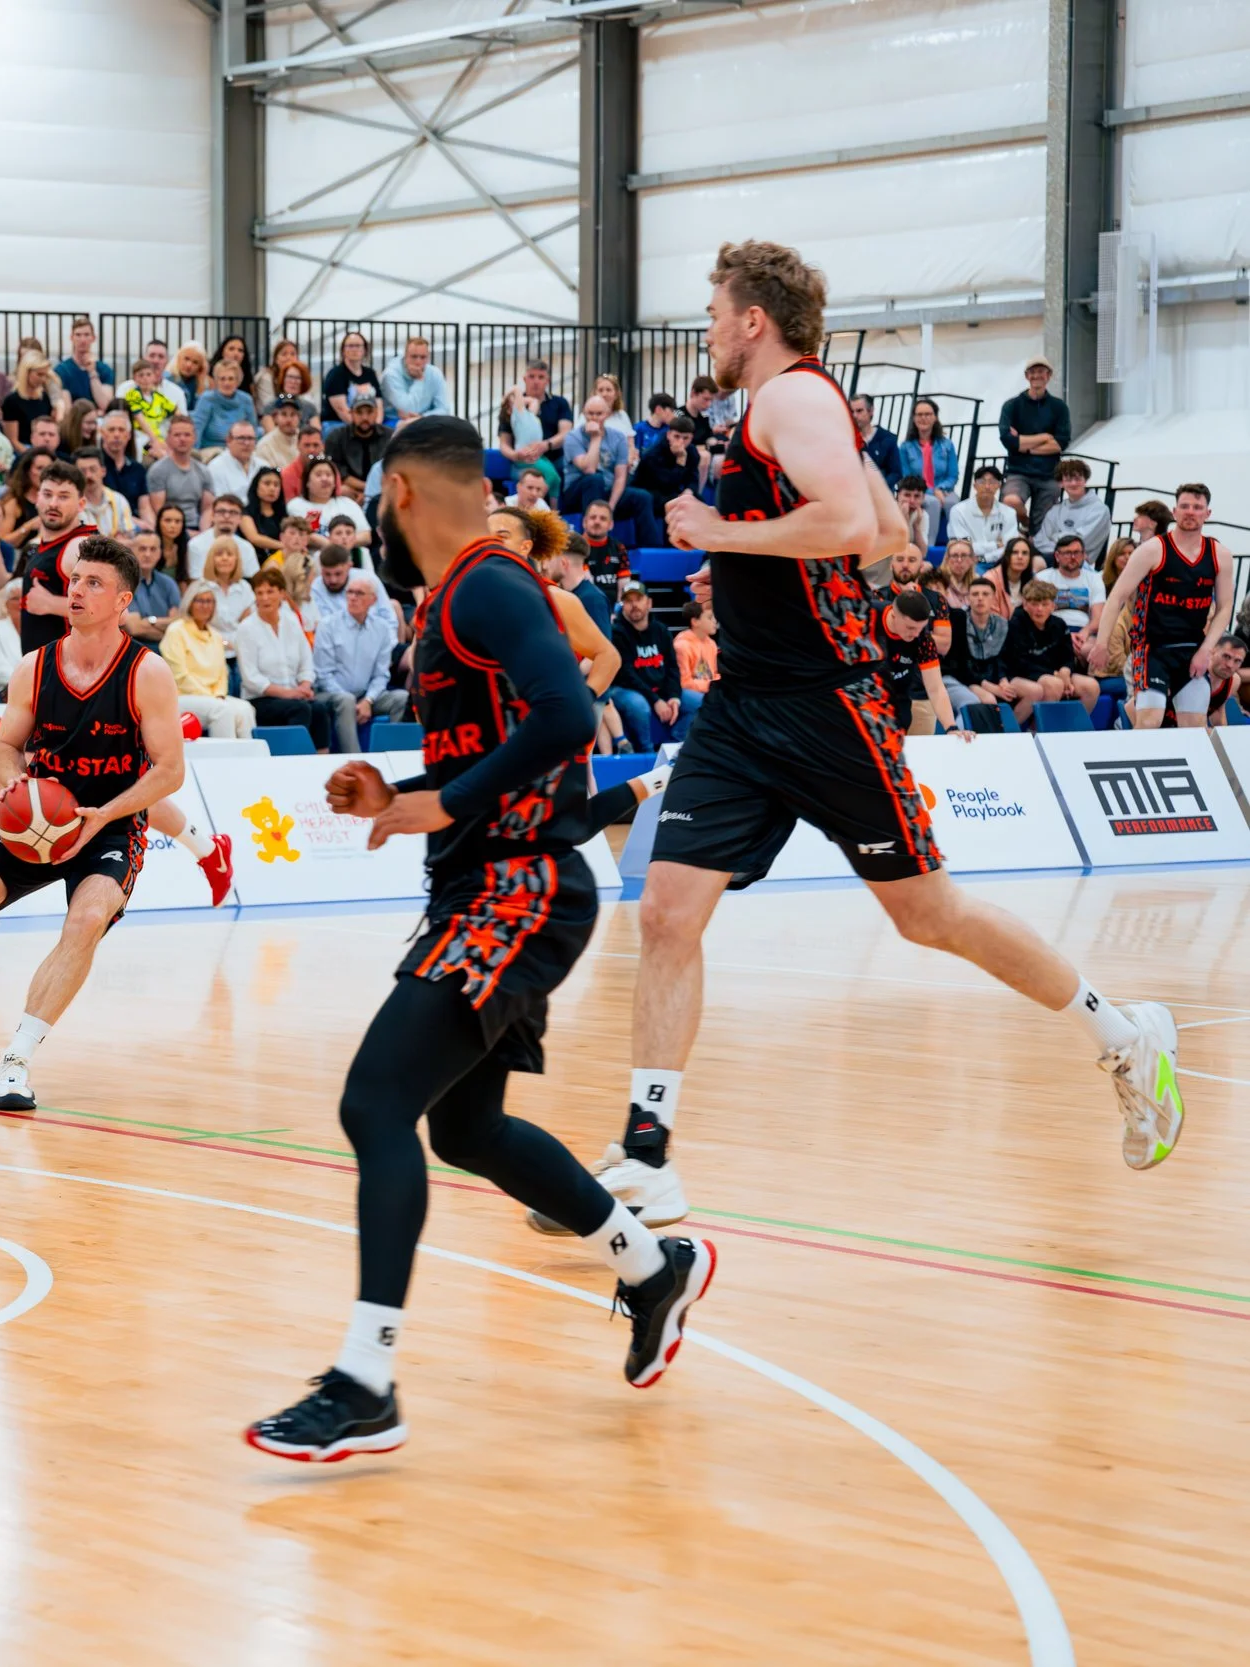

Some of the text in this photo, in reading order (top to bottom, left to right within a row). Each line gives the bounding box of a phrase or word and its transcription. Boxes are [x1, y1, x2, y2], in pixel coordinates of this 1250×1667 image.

[1154, 592, 1177, 605] ALL
[77, 753, 132, 776] STAR
[946, 787, 999, 804] People
[1084, 758, 1209, 816] MTA
[952, 802, 1026, 821] Playbook
[1113, 816, 1214, 835] PERFORMANCE
[305, 831, 350, 844] TRUST
